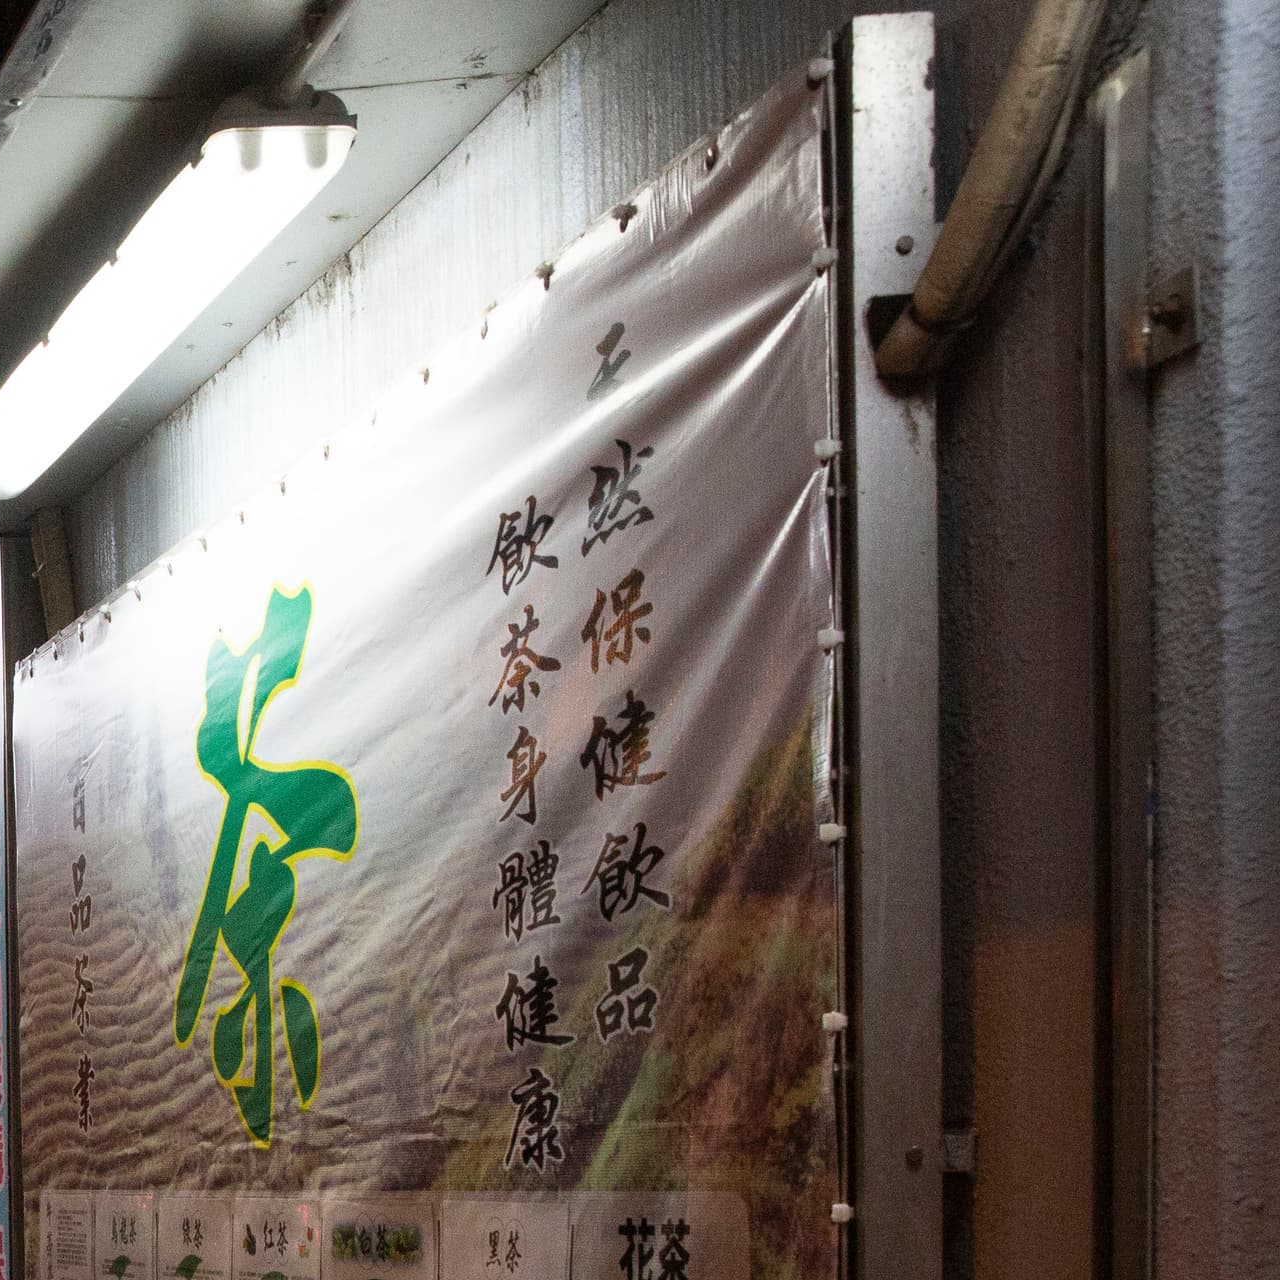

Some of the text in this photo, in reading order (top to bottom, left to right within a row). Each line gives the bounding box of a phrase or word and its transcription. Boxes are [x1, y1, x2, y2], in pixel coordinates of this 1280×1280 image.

[485, 495, 575, 1170] 飲茶身體健康
